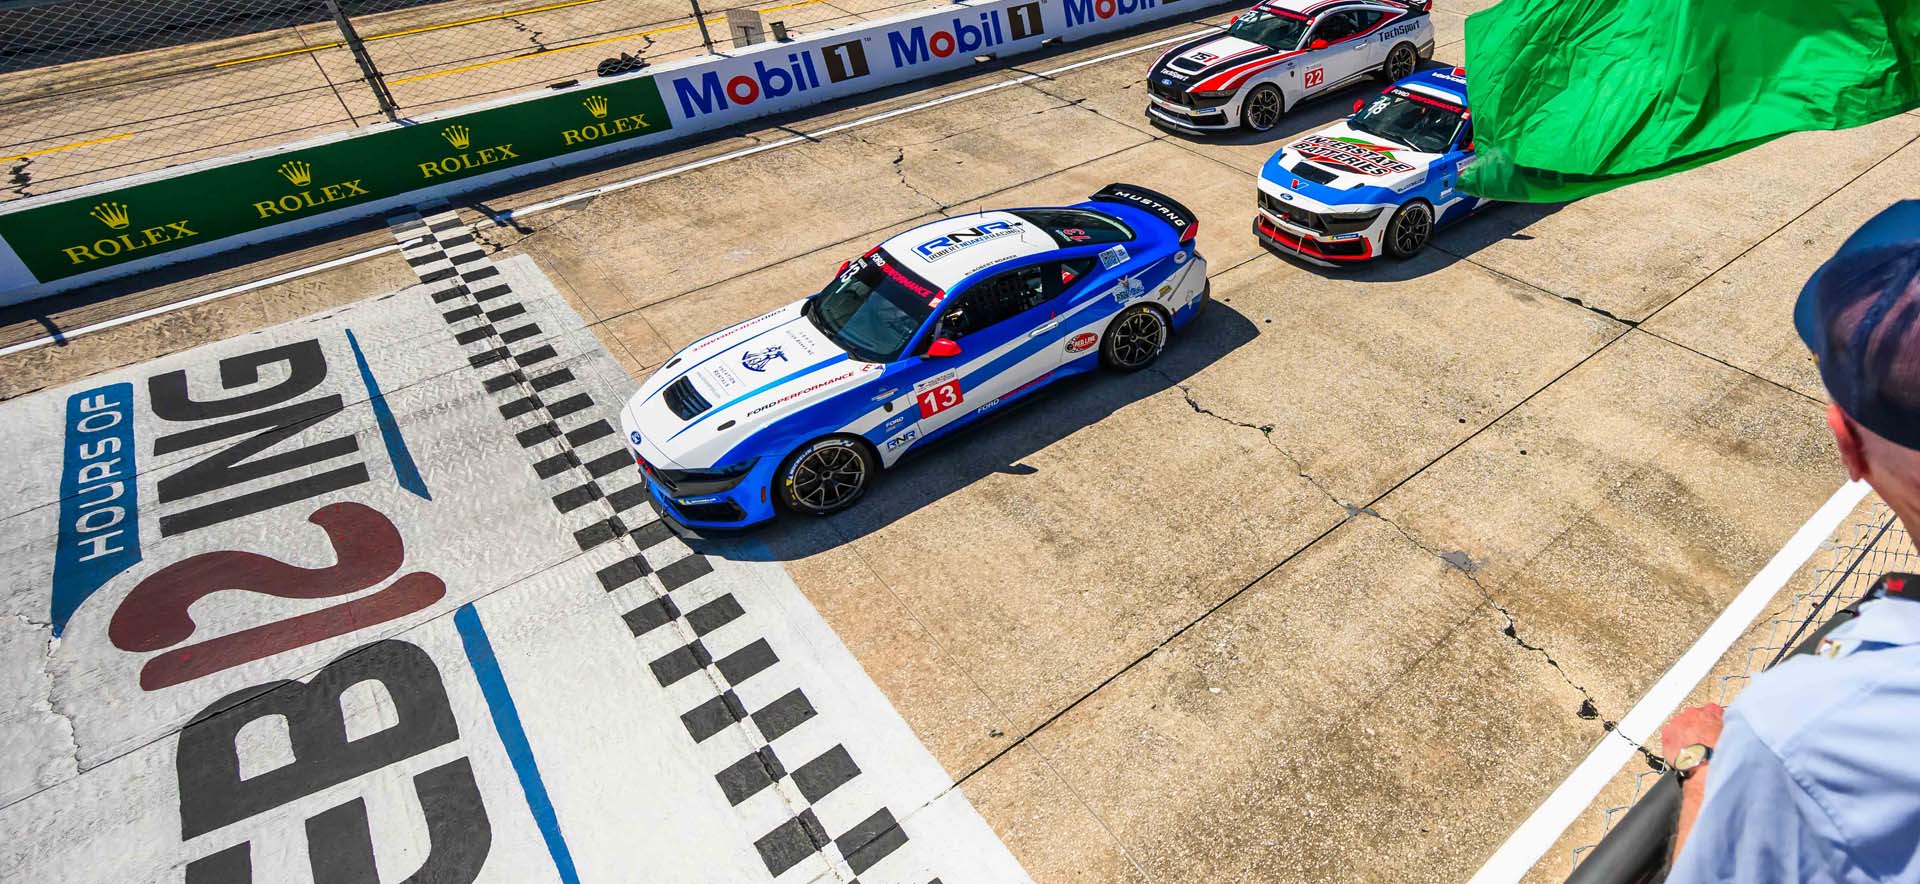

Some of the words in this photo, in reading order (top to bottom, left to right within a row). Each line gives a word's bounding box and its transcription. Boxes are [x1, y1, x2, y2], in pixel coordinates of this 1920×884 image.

[887, 9, 1004, 68] Mobil
[1015, 5, 1033, 37] 1
[1378, 20, 1421, 42] TechSport
[672, 50, 820, 119] Mobil
[834, 45, 855, 78] 1
[1160, 67, 1190, 82] TechSport
[1306, 69, 1322, 88] 22
[561, 113, 651, 146] ROLEX
[417, 142, 520, 179] ROLEX
[1292, 142, 1389, 176] BATTERIES
[1303, 135, 1410, 172] INTERSTATE
[252, 179, 371, 219] ROLEX
[1115, 191, 1187, 228] MUSTANG
[61, 218, 200, 265] ROLEX
[917, 221, 1012, 257] RNR
[928, 245, 960, 261] ROBERT
[77, 394, 123, 433] OF
[924, 385, 957, 413] 13
[887, 430, 917, 450] RNR
[75, 436, 126, 562] HOURS
